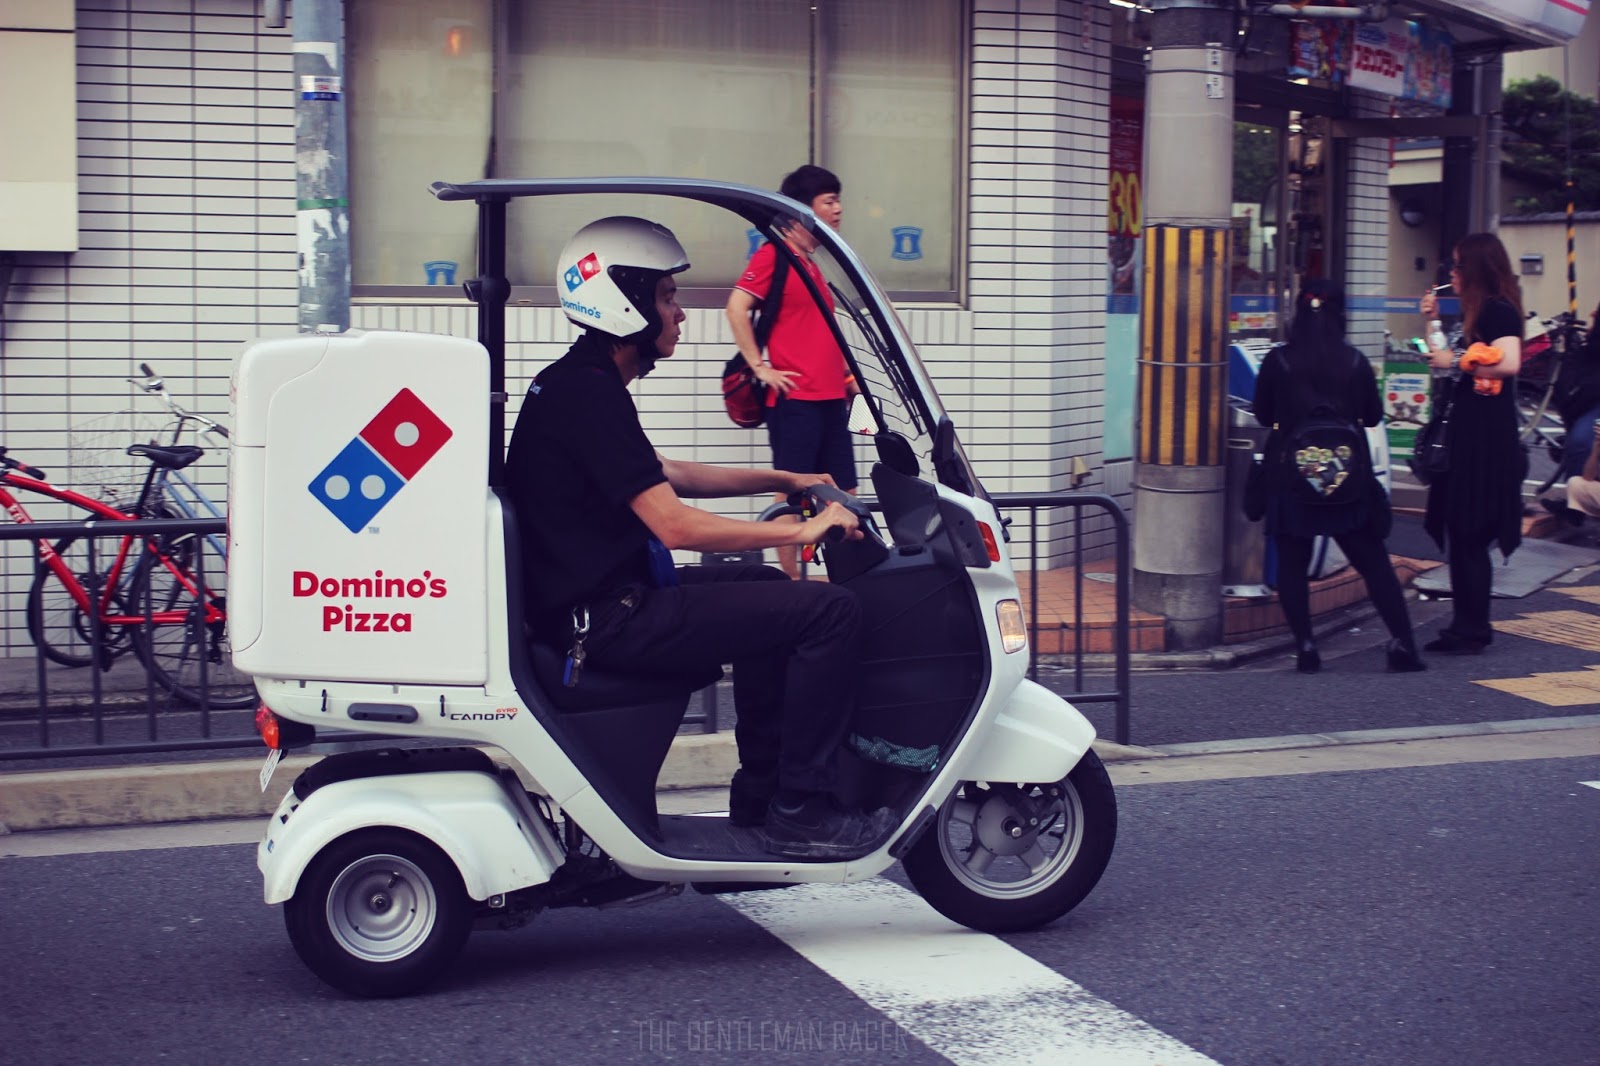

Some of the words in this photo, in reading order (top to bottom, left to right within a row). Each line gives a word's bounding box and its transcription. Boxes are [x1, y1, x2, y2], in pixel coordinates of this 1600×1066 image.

[561, 297, 601, 319] Domino's
[293, 570, 448, 599] Domino's
[322, 604, 412, 632] Pizza
[450, 713, 517, 721] CANOPY
